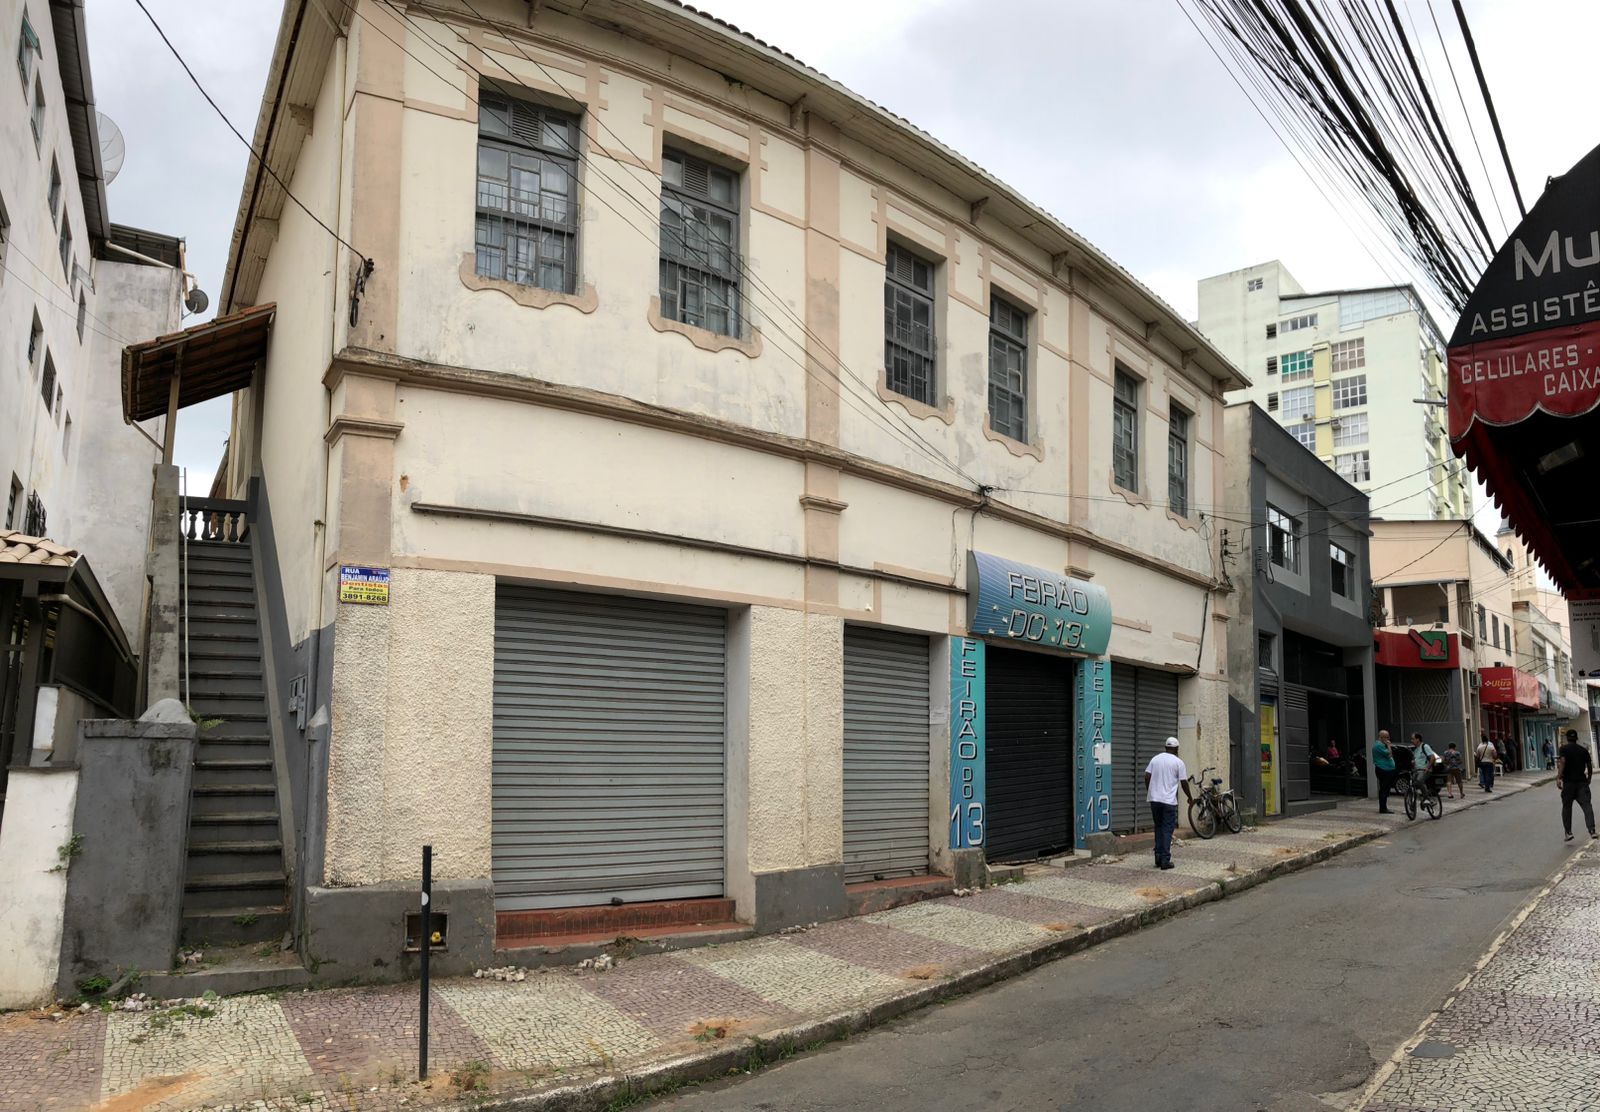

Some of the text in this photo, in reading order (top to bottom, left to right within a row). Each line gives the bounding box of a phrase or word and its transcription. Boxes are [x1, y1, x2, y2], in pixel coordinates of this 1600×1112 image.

[1470, 280, 1600, 336] ASSISTÊ
[1461, 344, 1579, 385] CELULARES
[342, 593, 387, 601] 3891-8268
[1008, 571, 1089, 616] FEIRÃO
[1008, 609, 1084, 648] DO 13
[962, 767, 973, 799] DO
[1094, 767, 1103, 793] DO
[951, 802, 984, 847] 13
[1087, 794, 1110, 831] 13
